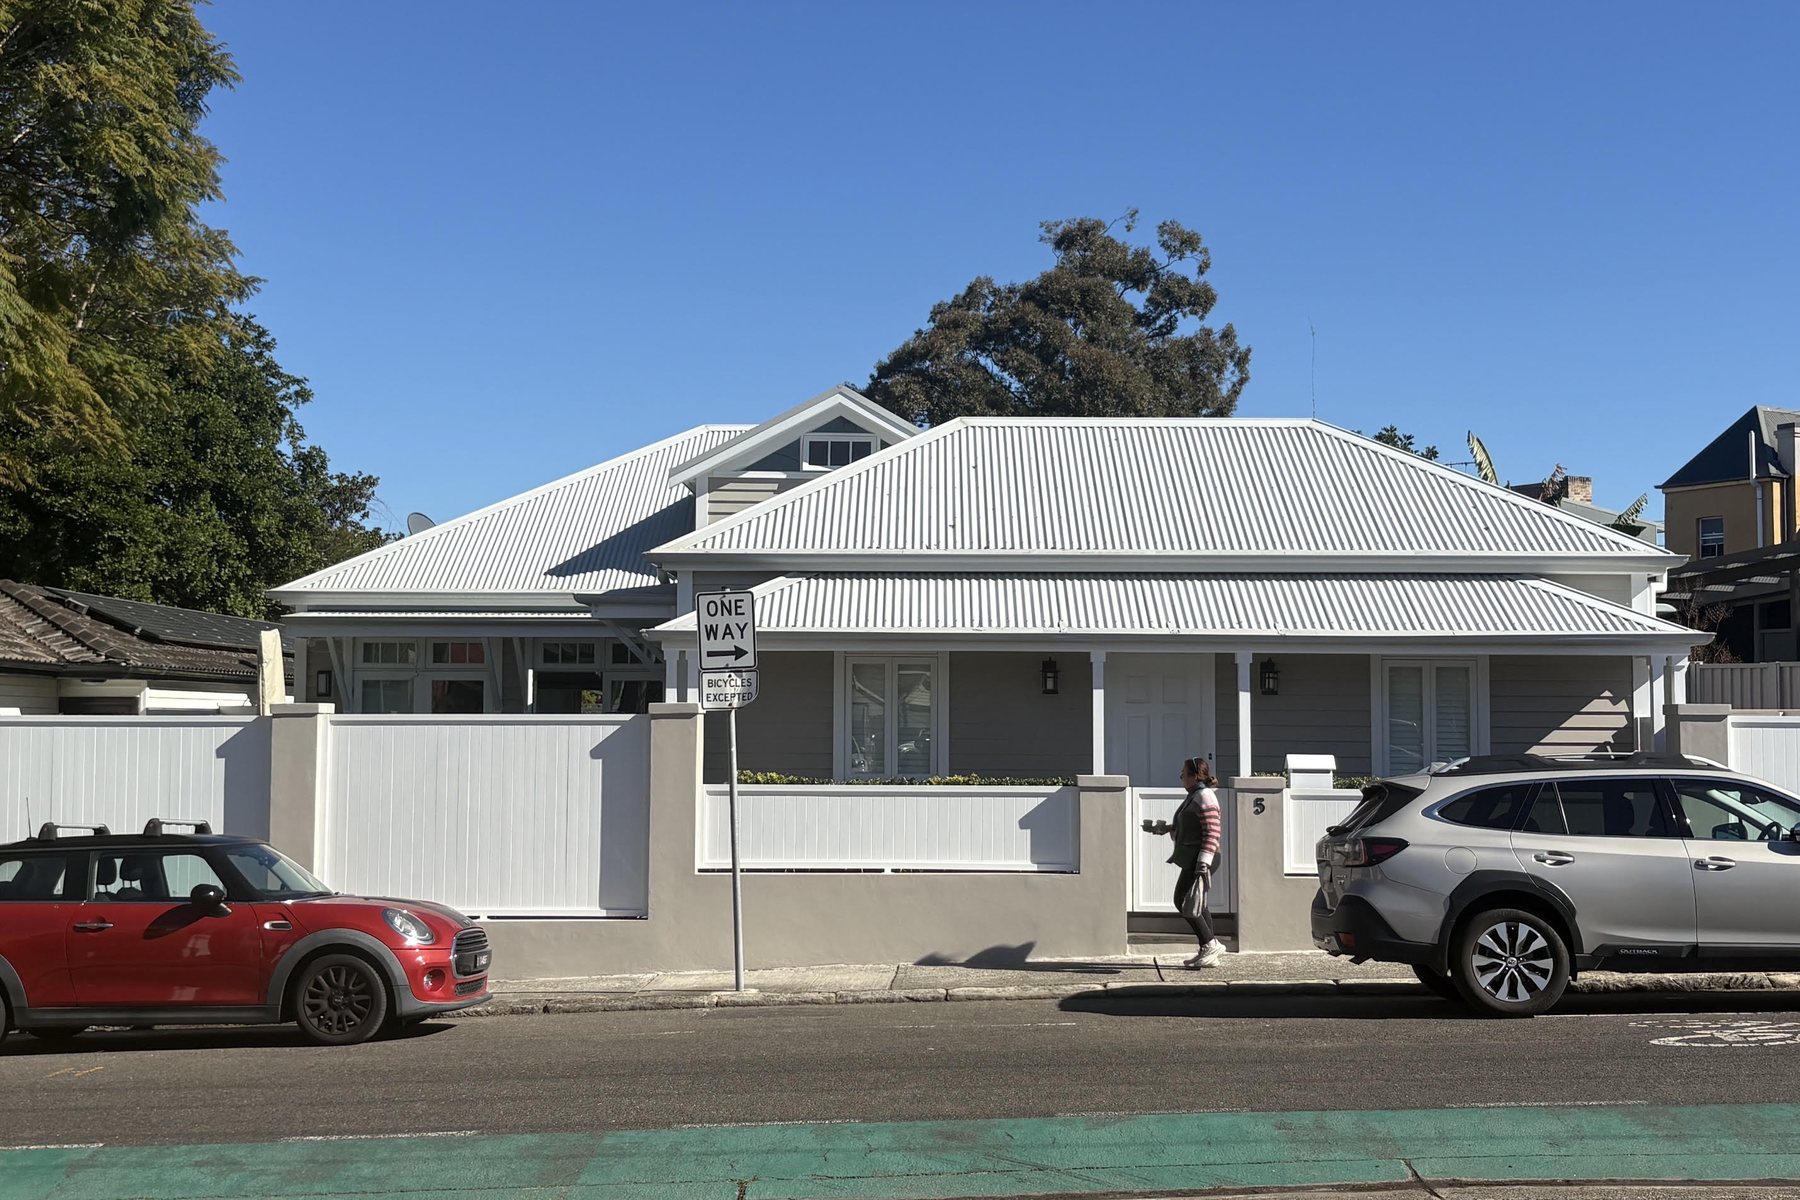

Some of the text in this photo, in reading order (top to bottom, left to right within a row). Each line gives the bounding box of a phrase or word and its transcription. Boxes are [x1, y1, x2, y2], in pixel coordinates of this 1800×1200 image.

[706, 599, 746, 617] ONE
[704, 622, 749, 641] WAY
[707, 678, 752, 688] BICYCLES
[706, 692, 753, 702] EXCEPTED
[1253, 797, 1265, 815] 5
